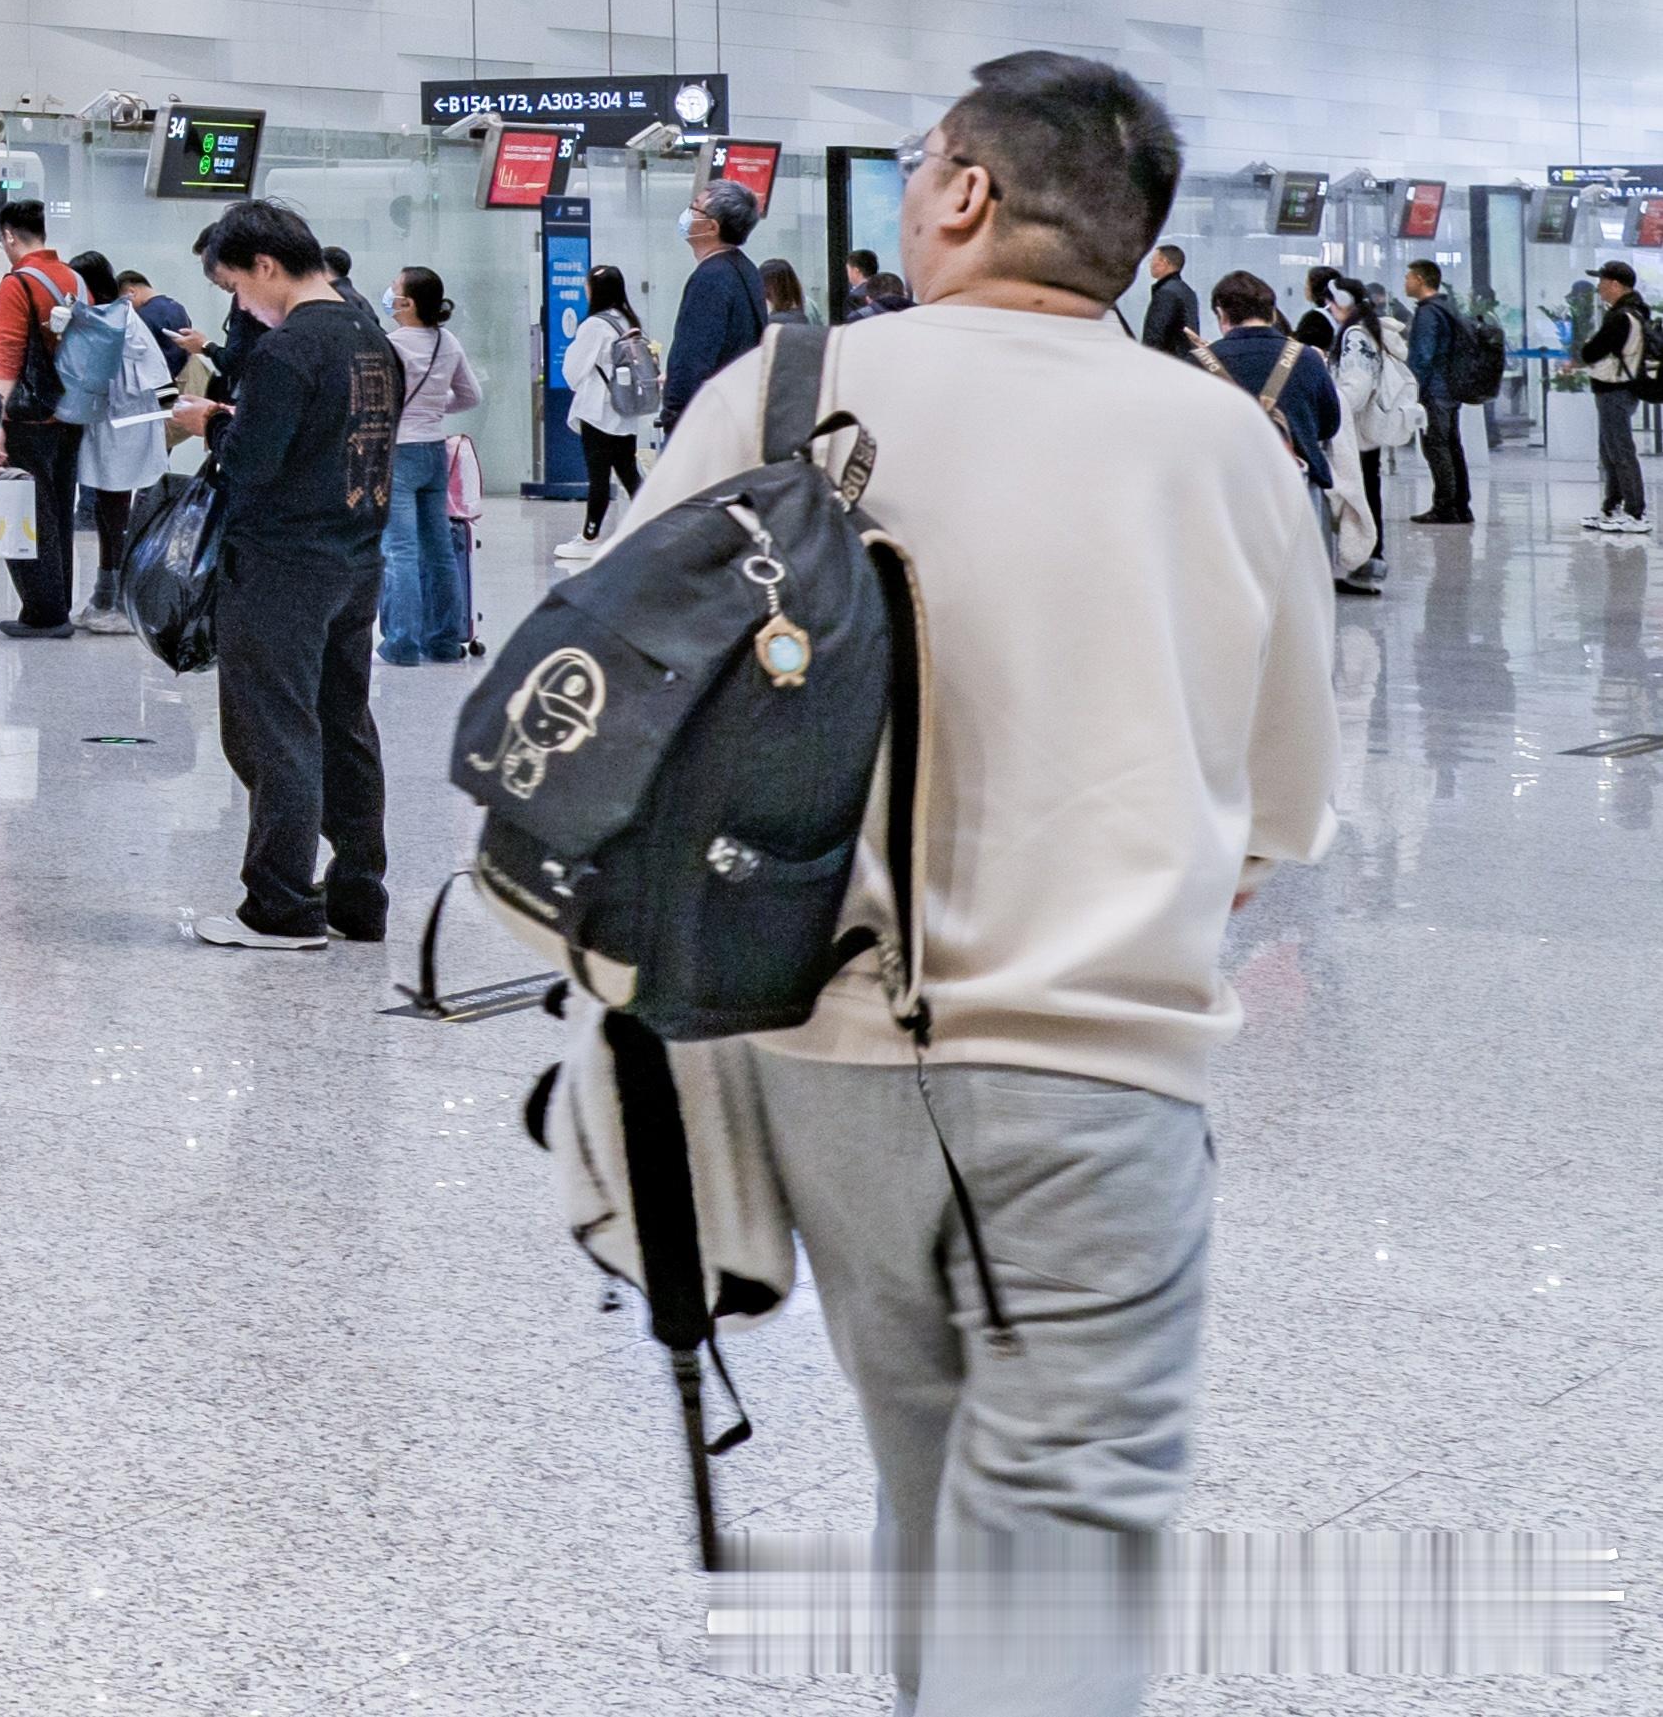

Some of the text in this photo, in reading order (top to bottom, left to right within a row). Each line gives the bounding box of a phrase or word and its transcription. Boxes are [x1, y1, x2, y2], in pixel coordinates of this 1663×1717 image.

[448, 94, 533, 114] B154-173,
[537, 91, 622, 112] A303-304
[167, 117, 187, 139] 34
[558, 139, 574, 158] 35
[712, 148, 727, 166] 36
